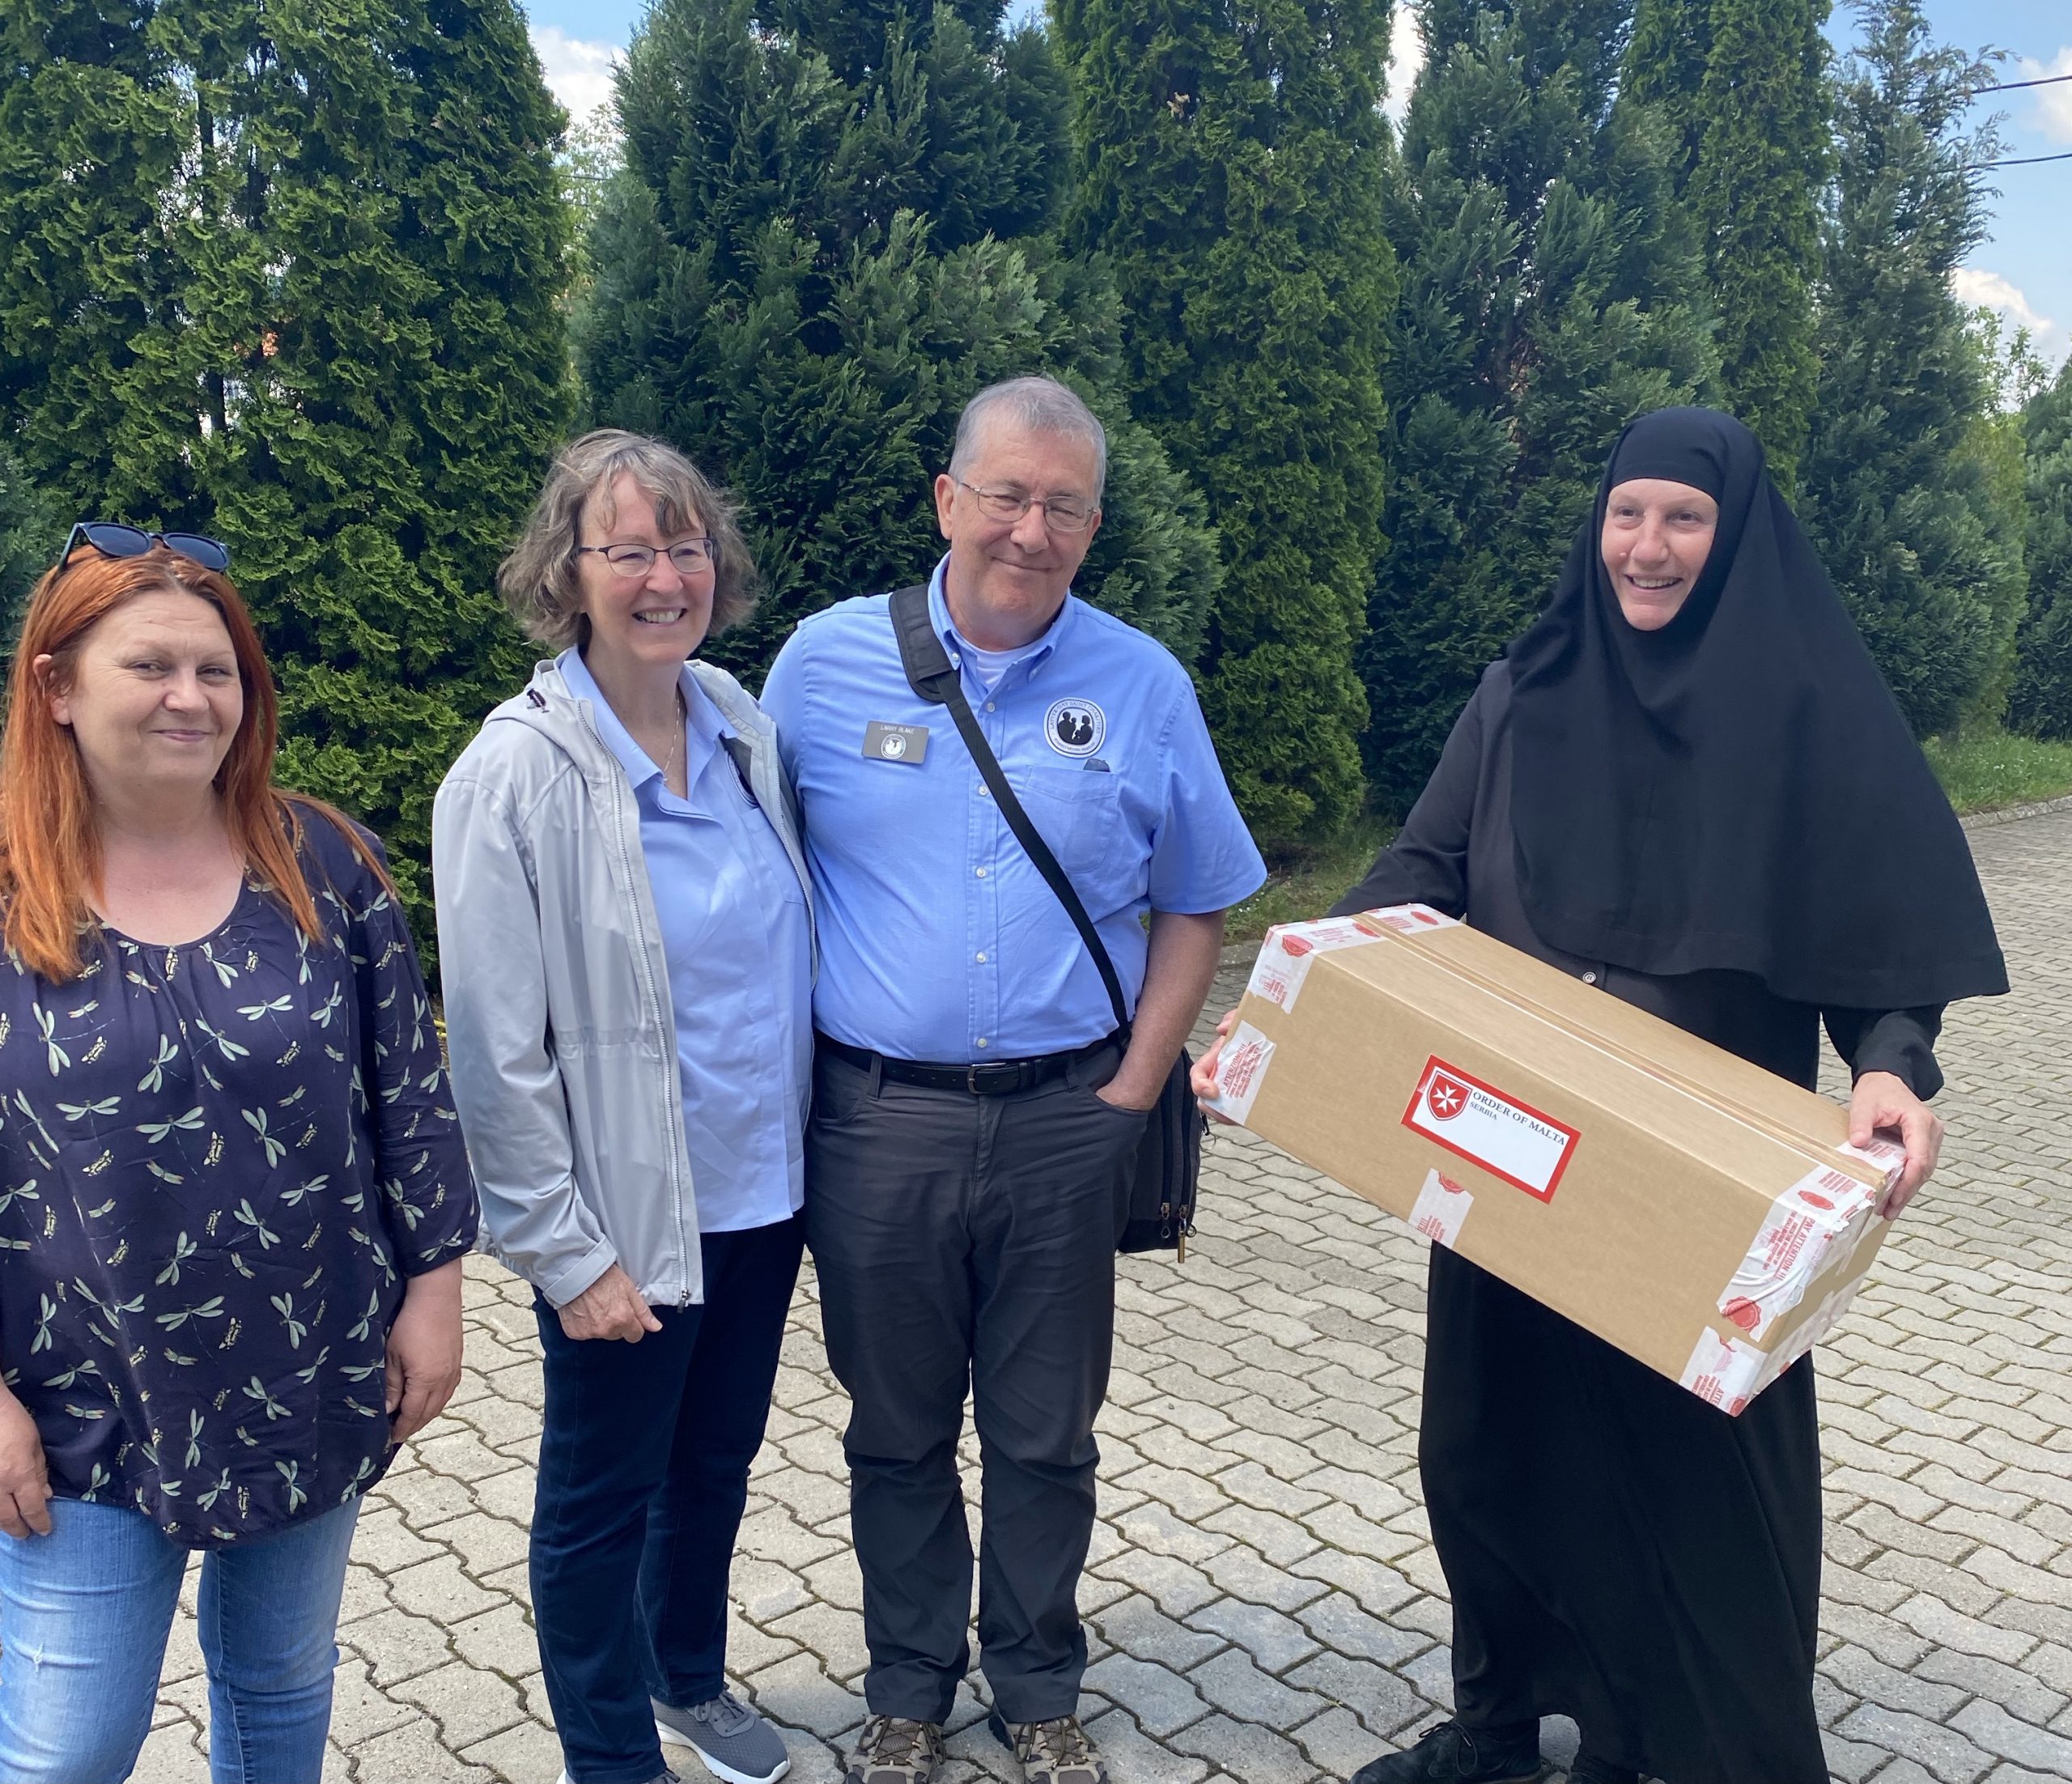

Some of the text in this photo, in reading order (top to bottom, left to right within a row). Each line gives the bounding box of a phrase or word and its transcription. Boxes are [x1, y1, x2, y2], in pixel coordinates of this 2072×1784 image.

[1051, 702, 1068, 730] LATTER-DAY
[1088, 704, 1102, 734] CHARITIES
[1470, 1102, 1497, 1121] SERBIA
[1473, 1091, 1565, 1145] ORDER OF MALTA
[1802, 1217, 1816, 1233] PAY
[1781, 1232, 1807, 1272] ATTENTION
